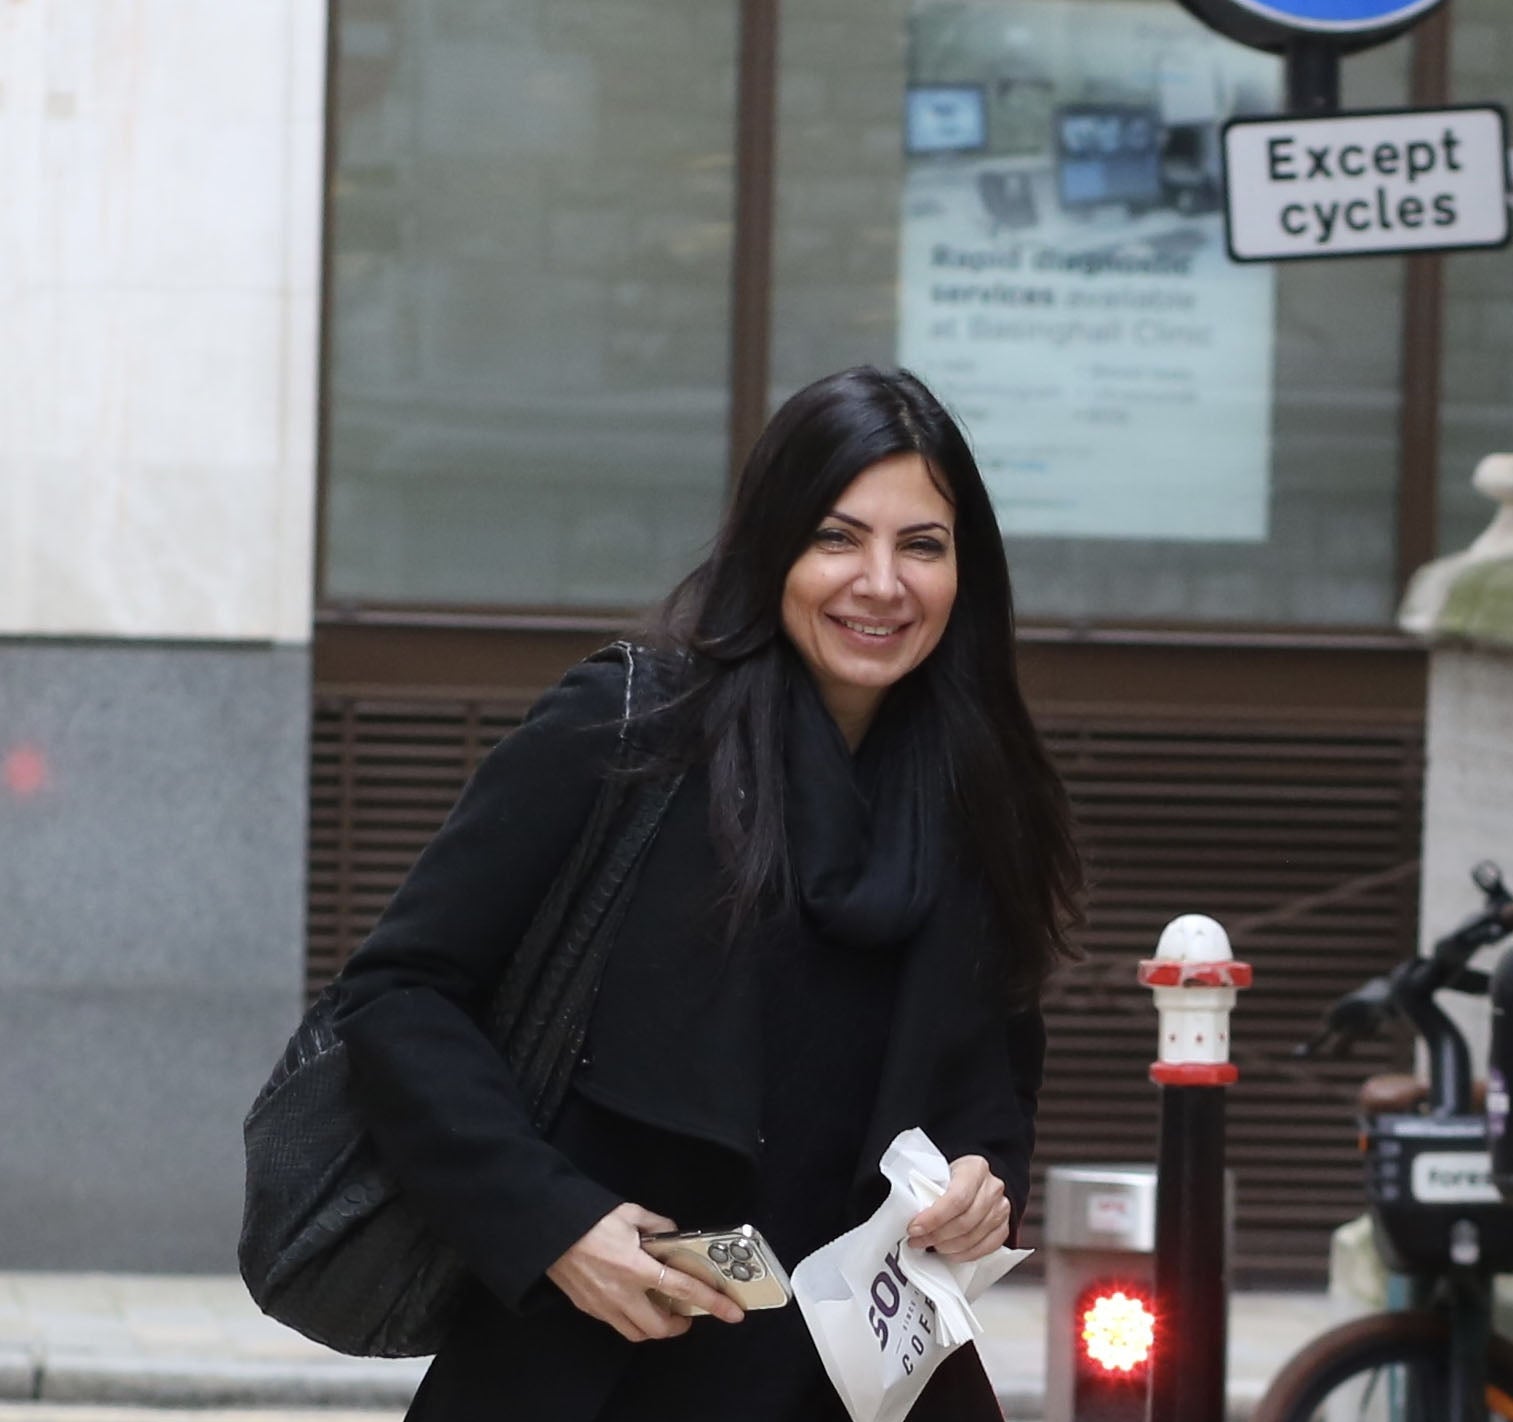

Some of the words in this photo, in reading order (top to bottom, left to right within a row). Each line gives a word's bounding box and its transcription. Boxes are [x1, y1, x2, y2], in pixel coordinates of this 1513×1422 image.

[1267, 128, 1463, 182] Except
[1280, 187, 1458, 243] cycles
[931, 243, 1020, 272] Rapid
[930, 284, 1055, 306] services
